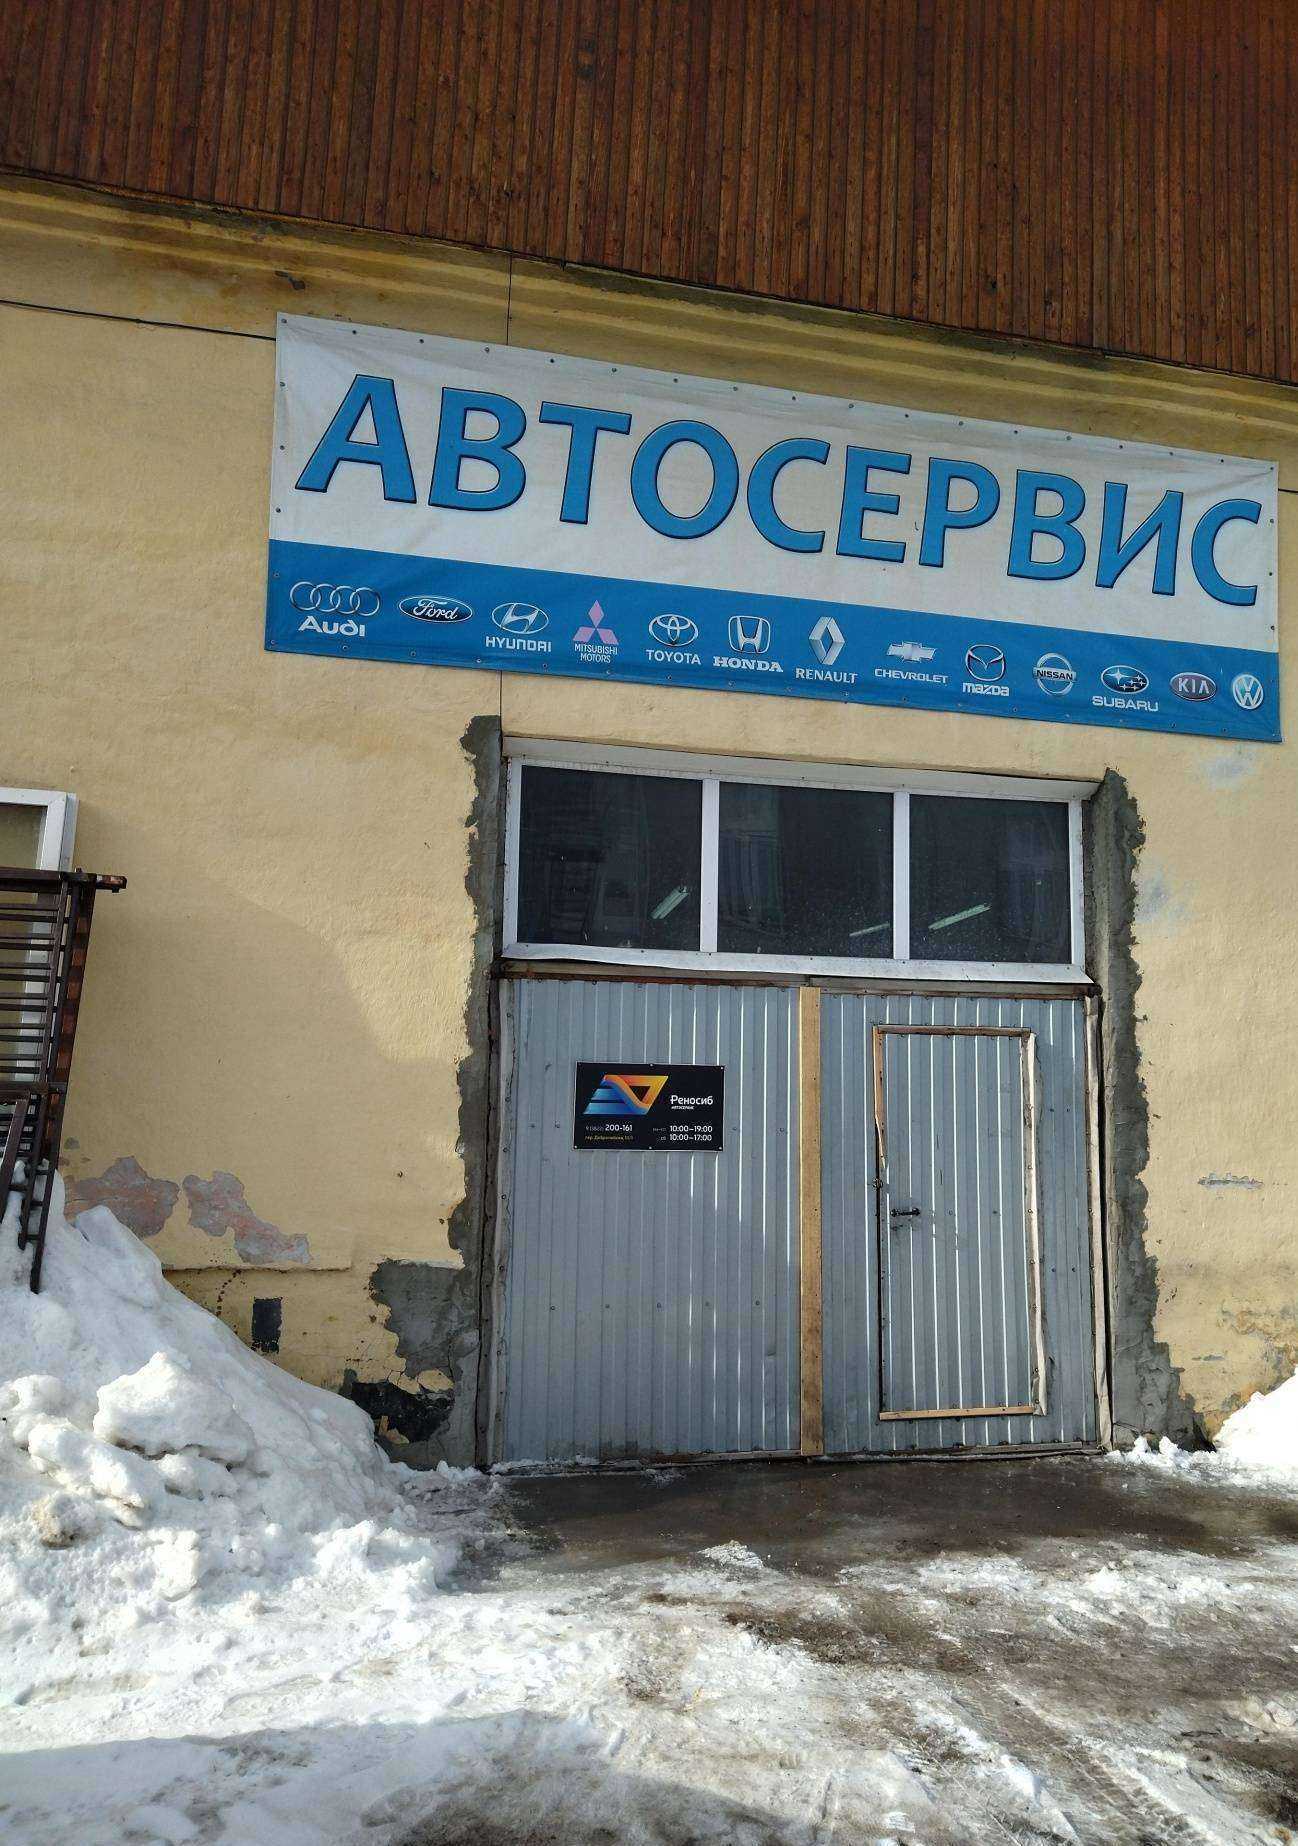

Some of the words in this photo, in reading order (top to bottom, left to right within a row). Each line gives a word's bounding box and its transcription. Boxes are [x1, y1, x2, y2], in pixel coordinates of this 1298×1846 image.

[295, 374, 1261, 606] АВТОСЕРВИС
[413, 599, 459, 620] Ford
[299, 615, 366, 637] Audi
[485, 636, 551, 652] HYUNDAI
[574, 643, 618, 656] MITSUBISHI
[580, 653, 612, 664] MOTORS
[646, 649, 702, 665] TOYOTA
[713, 656, 784, 673] HONDA
[795, 668, 858, 684] RENAULT
[874, 668, 949, 684] CHEVROLET
[1036, 670, 1073, 681] NISSAN
[1178, 677, 1210, 694] KIA
[1092, 695, 1158, 712] SUBARU
[670, 1095, 714, 1105] Реносиб
